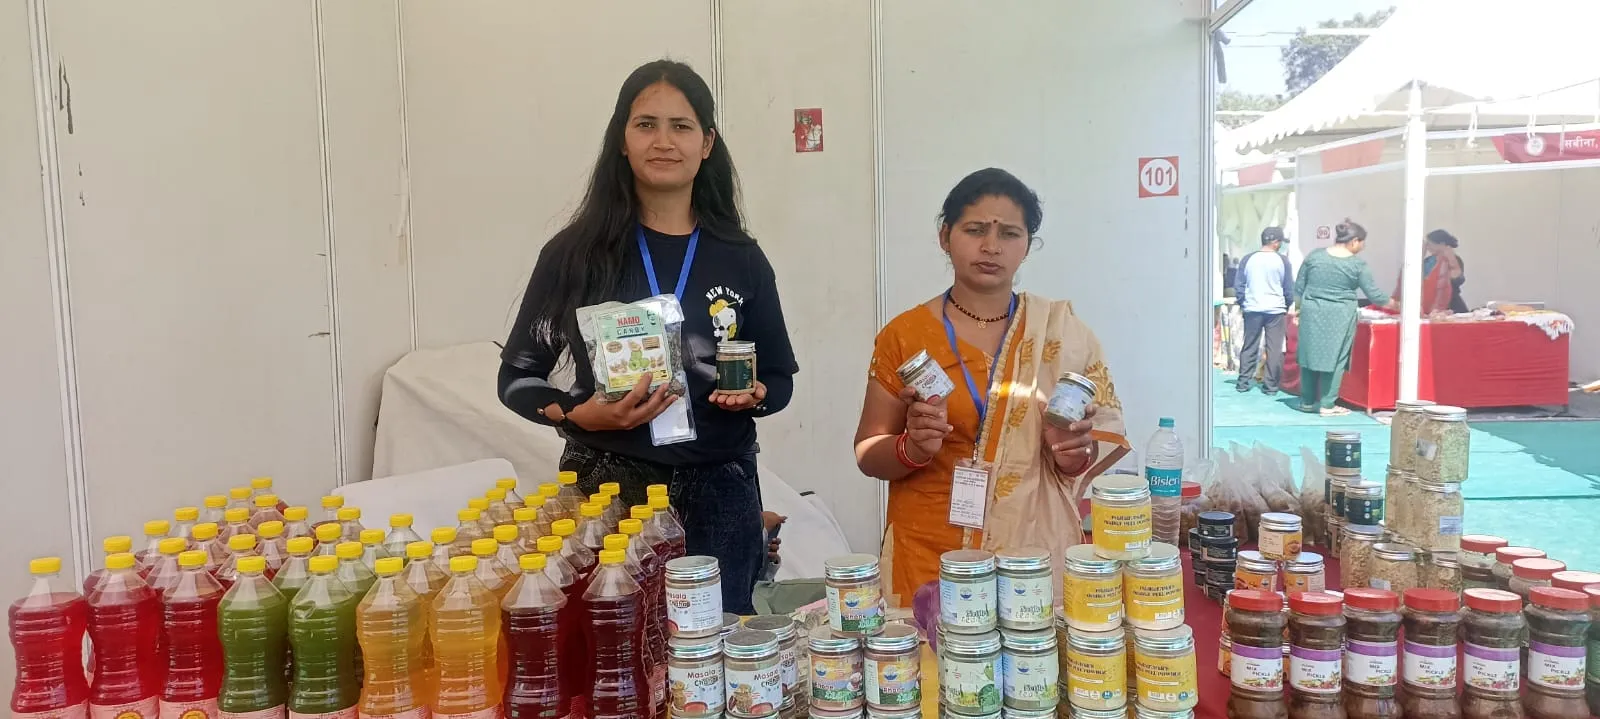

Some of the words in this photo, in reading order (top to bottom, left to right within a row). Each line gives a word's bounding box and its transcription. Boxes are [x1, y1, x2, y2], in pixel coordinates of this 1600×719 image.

[1145, 167, 1173, 186] 101
[706, 285, 723, 302] NEW
[724, 286, 744, 307] YORK
[687, 667, 717, 680] Masala
